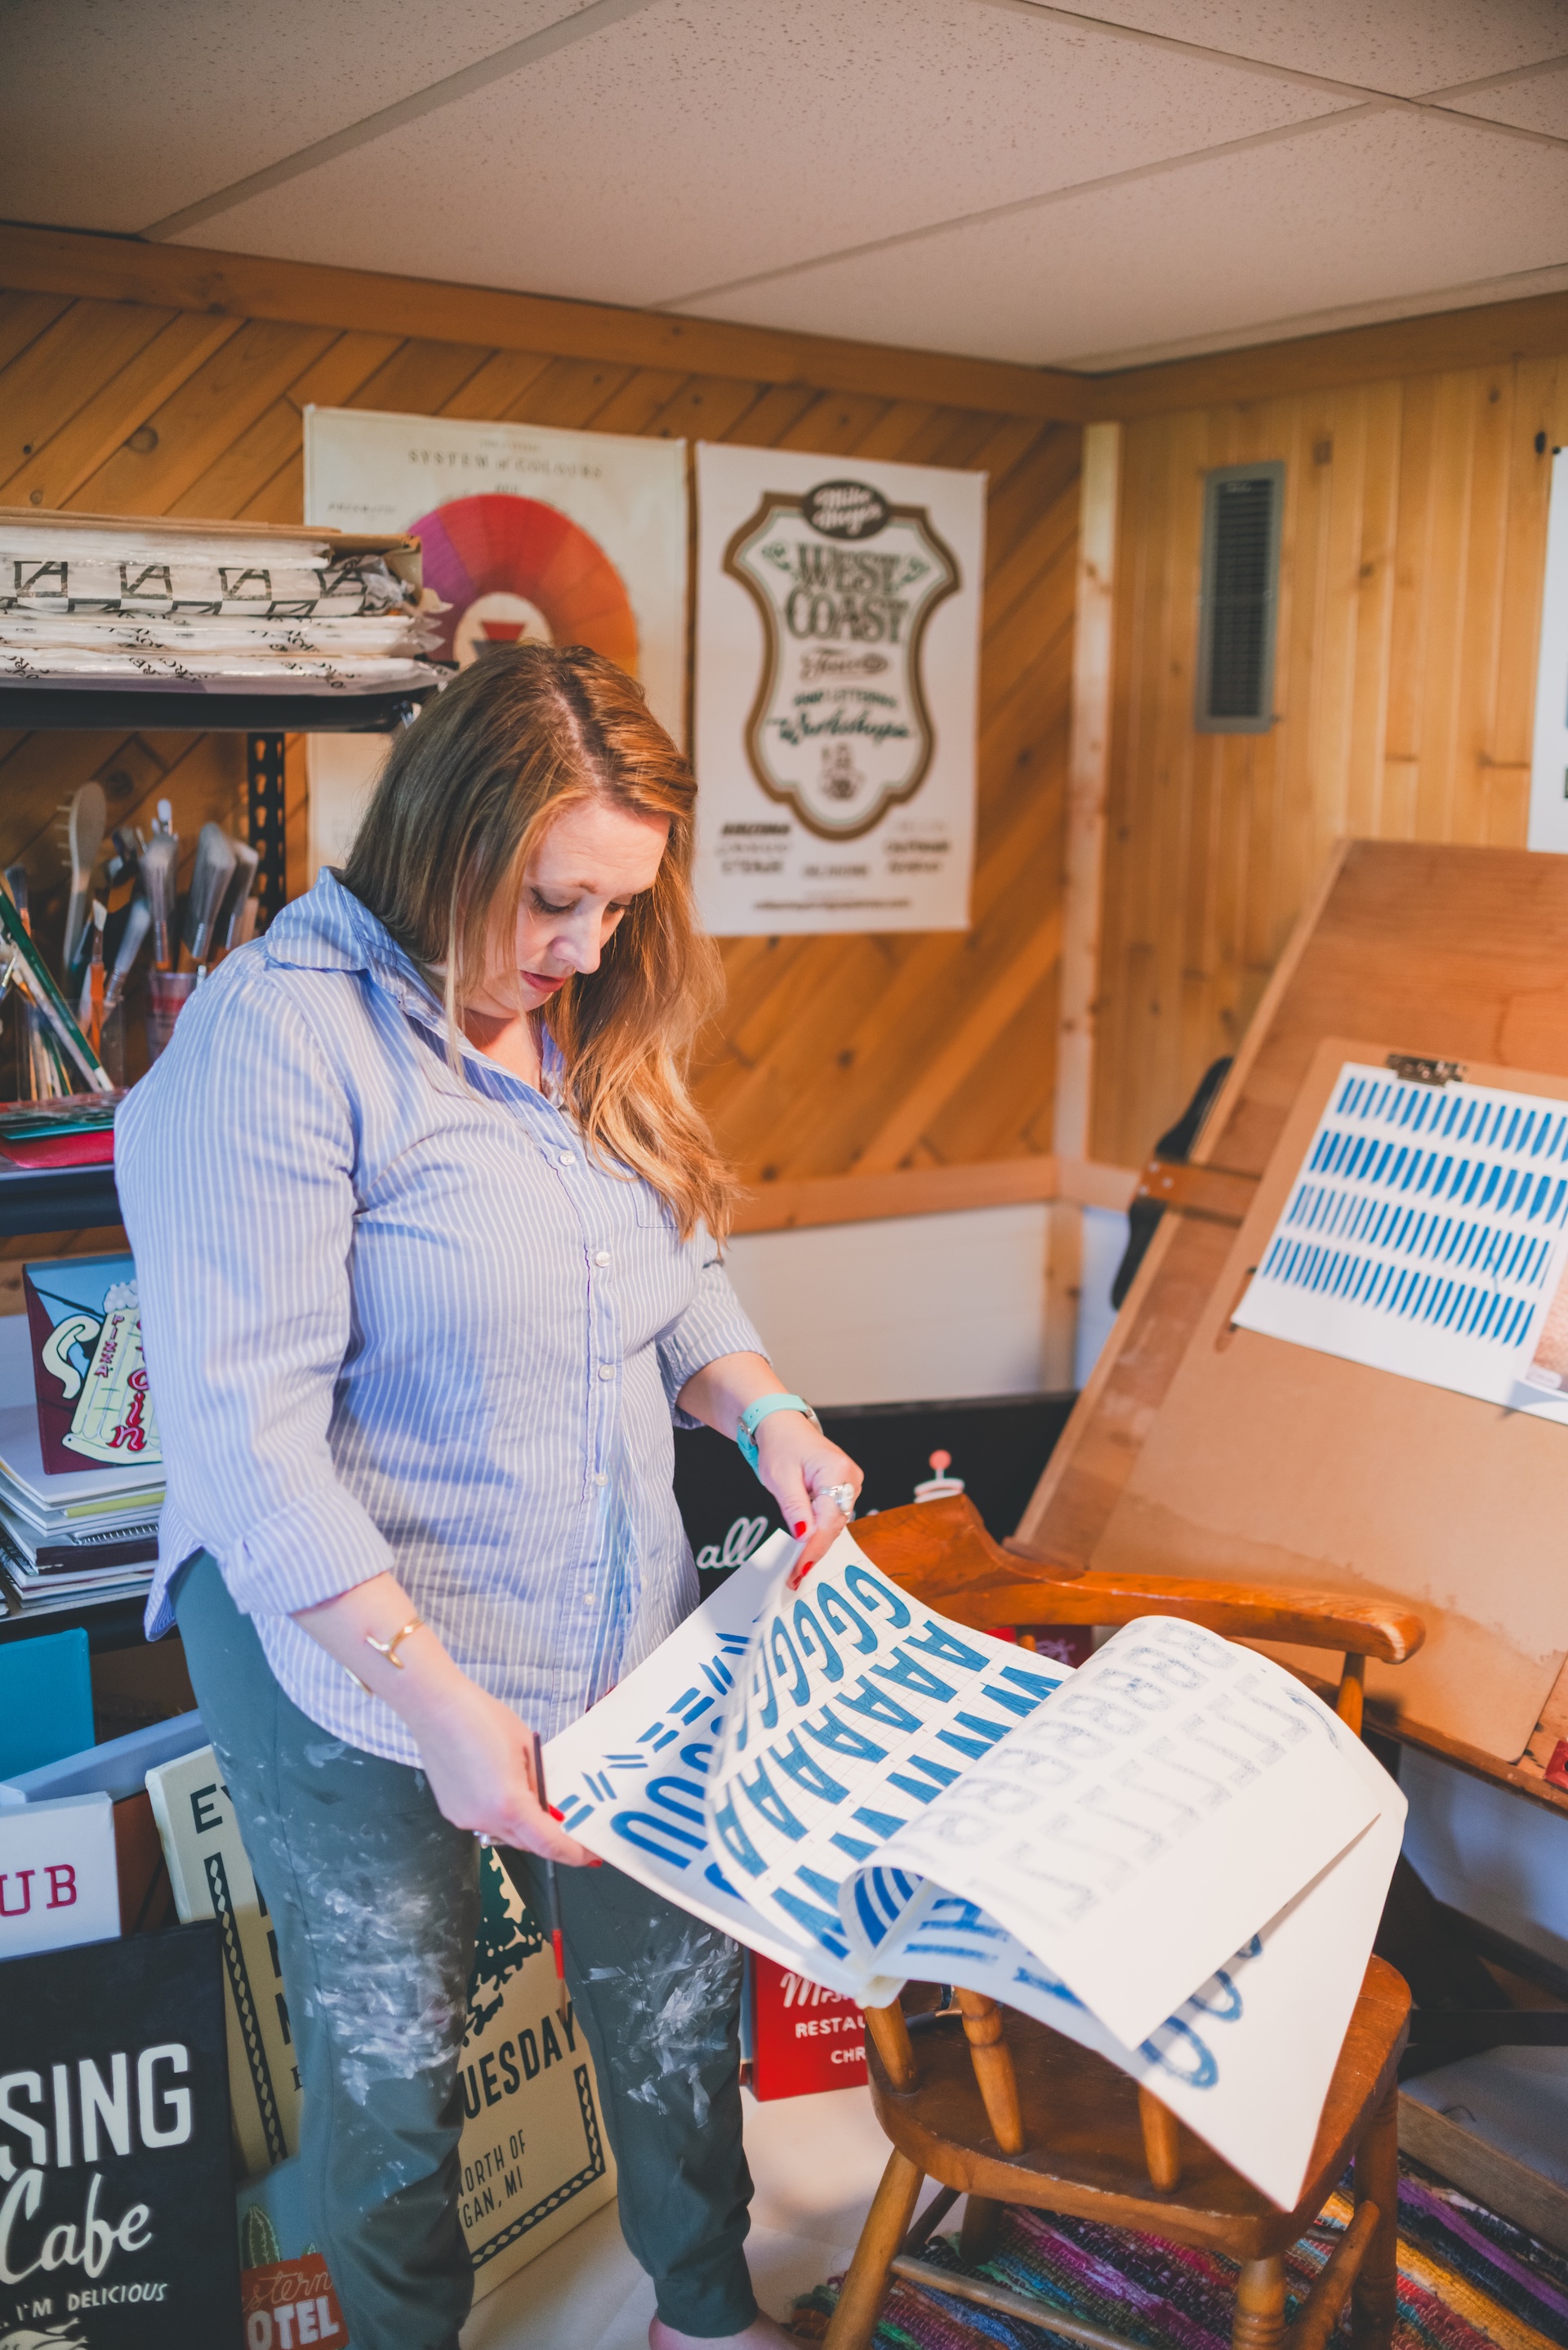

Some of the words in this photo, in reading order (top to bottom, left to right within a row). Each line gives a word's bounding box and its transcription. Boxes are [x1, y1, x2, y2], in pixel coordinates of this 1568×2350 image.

[798, 543, 900, 595] WEST
[786, 586, 910, 644] COAST
[94, 1314, 125, 1378] PIZZA
[697, 1515, 768, 1569] all
[189, 1783, 233, 1835] E
[0, 1864, 77, 1917] UB
[458, 2001, 576, 2120] UESDAY
[0, 2043, 192, 2182] SING
[510, 2129, 526, 2160] OF
[457, 2187, 501, 2229] GAN,
[505, 2165, 523, 2199] MI
[0, 2169, 153, 2285] Cafe
[67, 2283, 168, 2312] DELICIOUS
[242, 2271, 332, 2313] stern
[247, 2295, 340, 2350] OTEL
